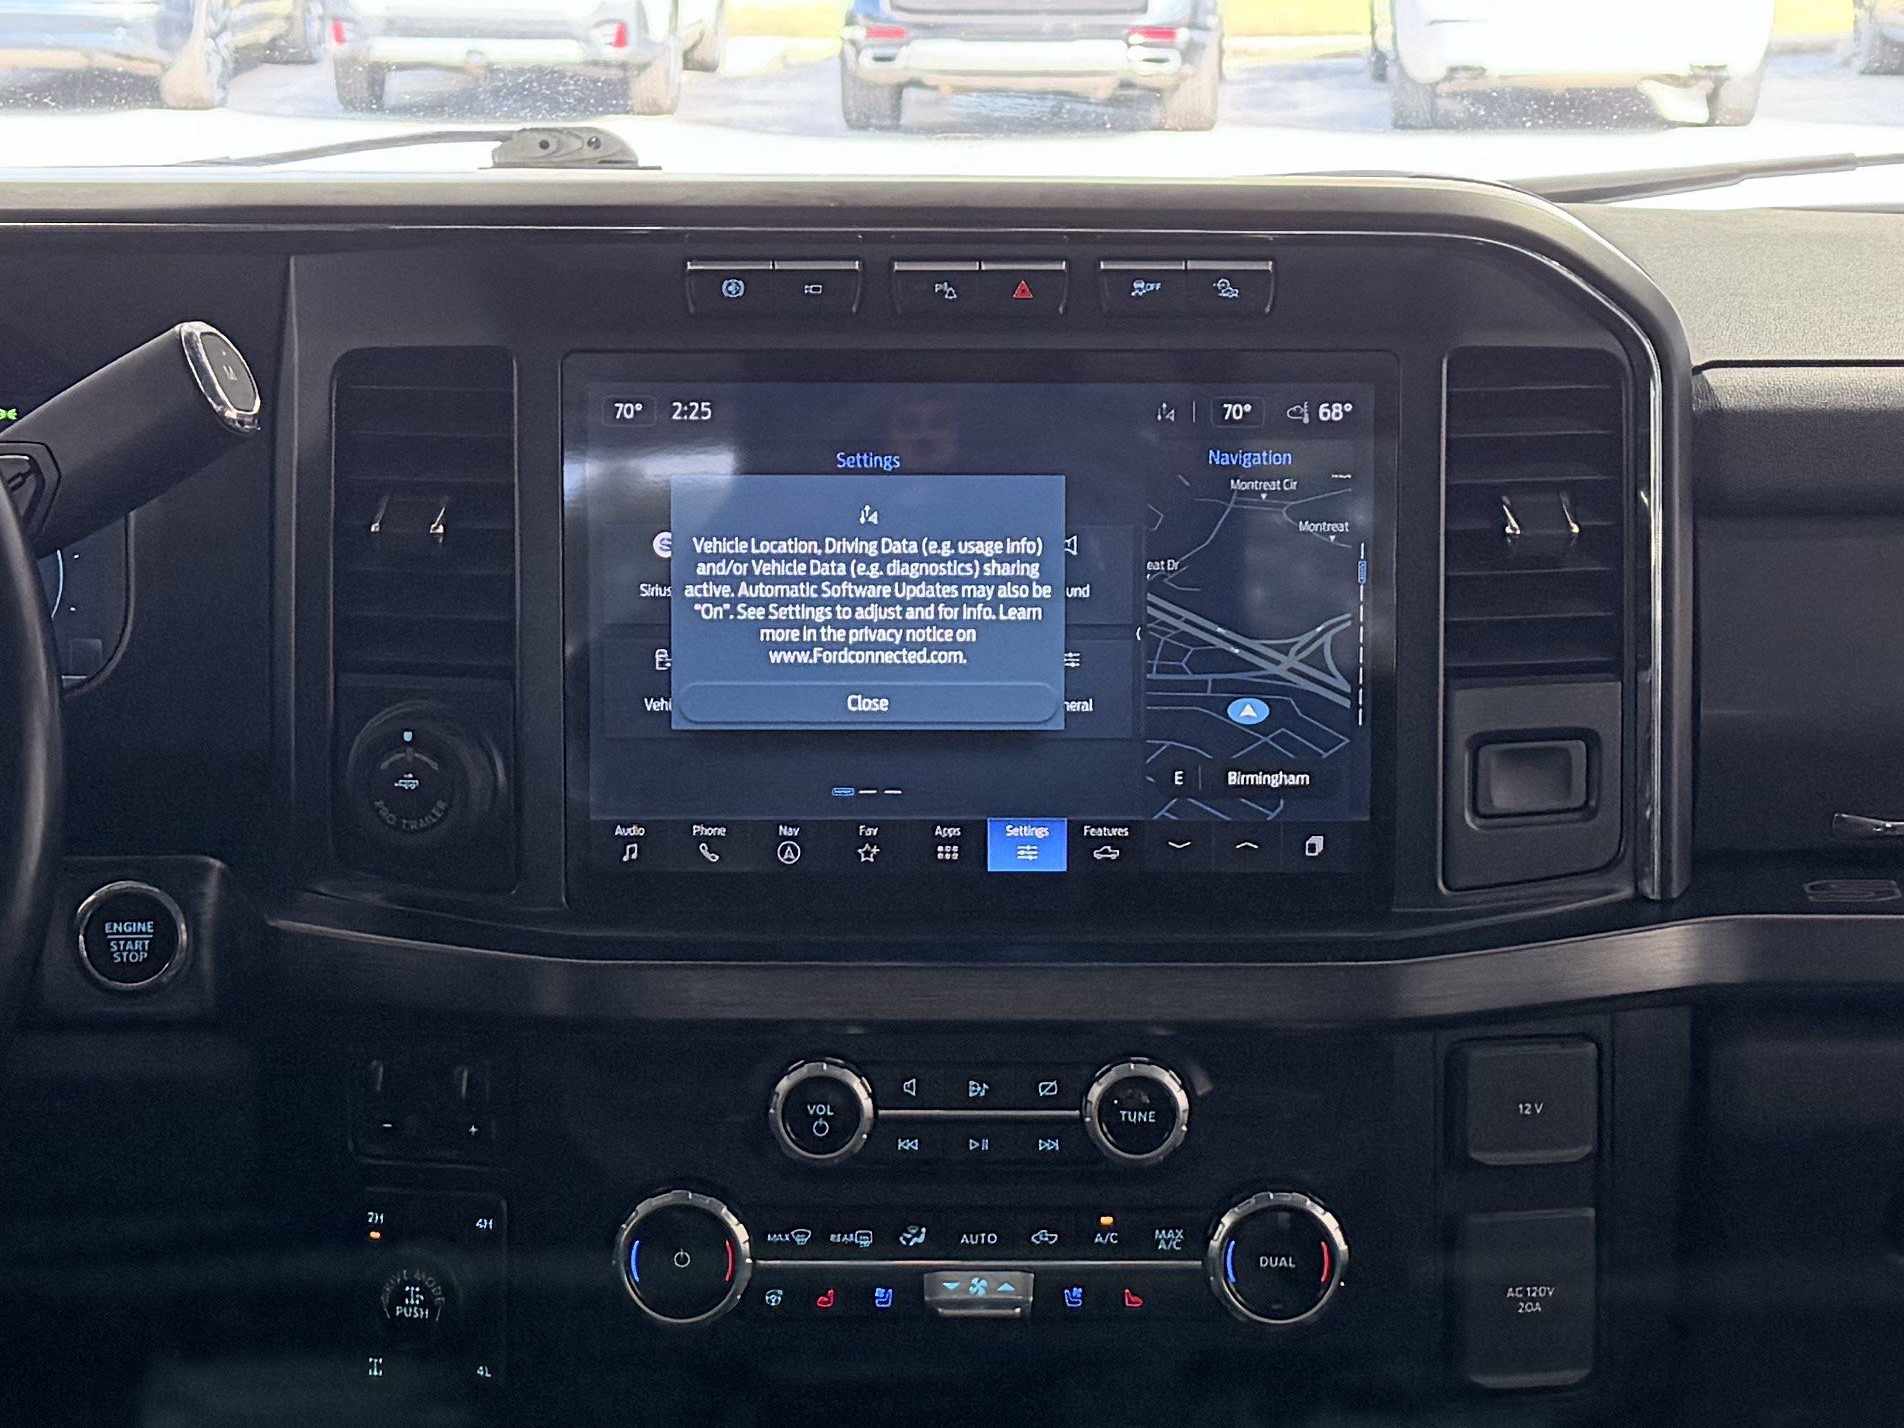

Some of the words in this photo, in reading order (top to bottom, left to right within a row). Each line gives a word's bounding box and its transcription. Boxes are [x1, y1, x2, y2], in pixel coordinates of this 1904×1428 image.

[614, 402, 643, 420] 70°
[671, 401, 713, 421] 2:25
[1223, 403, 1252, 420] 70°
[1318, 402, 1353, 422] 68°
[836, 452, 901, 471] Settings
[1208, 449, 1293, 469] Navigation
[1230, 478, 1282, 491] Montreat
[1298, 520, 1350, 533] Montreat
[692, 536, 749, 554] Vehicle
[750, 536, 823, 556] Location,
[824, 536, 879, 557] Driving
[881, 537, 919, 554] Data
[921, 536, 955, 557] (e.g.
[958, 539, 1004, 557] usage
[696, 558, 749, 576] and/or
[751, 559, 807, 576] Vehicle
[809, 559, 847, 576] Data
[850, 559, 884, 579] (e.g.
[886, 559, 980, 579] diagnostics)
[983, 560, 1041, 579] sharing
[1167, 559, 1181, 571] Dr
[684, 580, 735, 598] active.
[737, 580, 819, 598] Automatic
[821, 580, 892, 598] Software
[894, 581, 959, 601] Updates
[961, 584, 995, 601] may
[997, 581, 1029, 599] also
[1031, 582, 1052, 599] be
[736, 603, 766, 620] See
[767, 603, 833, 623] Settings
[835, 603, 853, 620] to
[854, 603, 903, 623] adjust
[905, 603, 935, 620] and
[937, 603, 960, 620] for
[999, 604, 1043, 621] Learn
[759, 627, 800, 642] more
[819, 625, 847, 642] the
[848, 625, 903, 645] privacy
[905, 625, 954, 642] notice
[955, 628, 977, 642] on
[768, 646, 969, 665] www.Fordconnected.com.
[847, 694, 889, 712] Close
[1174, 770, 1184, 786] E
[1227, 770, 1310, 789] Birmingham
[614, 824, 646, 837] Audio
[692, 824, 727, 837] Phone
[778, 824, 800, 837] Nav
[859, 824, 879, 837] Fav
[934, 824, 961, 839] Apps
[1005, 824, 1050, 839] Settings
[1083, 824, 1129, 837] Features
[104, 920, 155, 933] ENGINE
[109, 939, 150, 952] START
[112, 951, 148, 963] STOP
[806, 1102, 834, 1116] VOL
[1518, 1102, 1531, 1115] 12
[1533, 1102, 1544, 1114] V
[1118, 1109, 1157, 1124] TUNE
[767, 1233, 791, 1243] MAX
[960, 1232, 998, 1245] AUTO
[1094, 1231, 1119, 1245] A/C
[1154, 1228, 1184, 1241] MAX
[1157, 1238, 1182, 1251] A/C
[1259, 1254, 1297, 1269] DUAL
[1506, 1286, 1524, 1299] AC
[1525, 1285, 1556, 1299] 120V
[395, 1305, 429, 1319] PUSH
[476, 1365, 492, 1378] 4L
